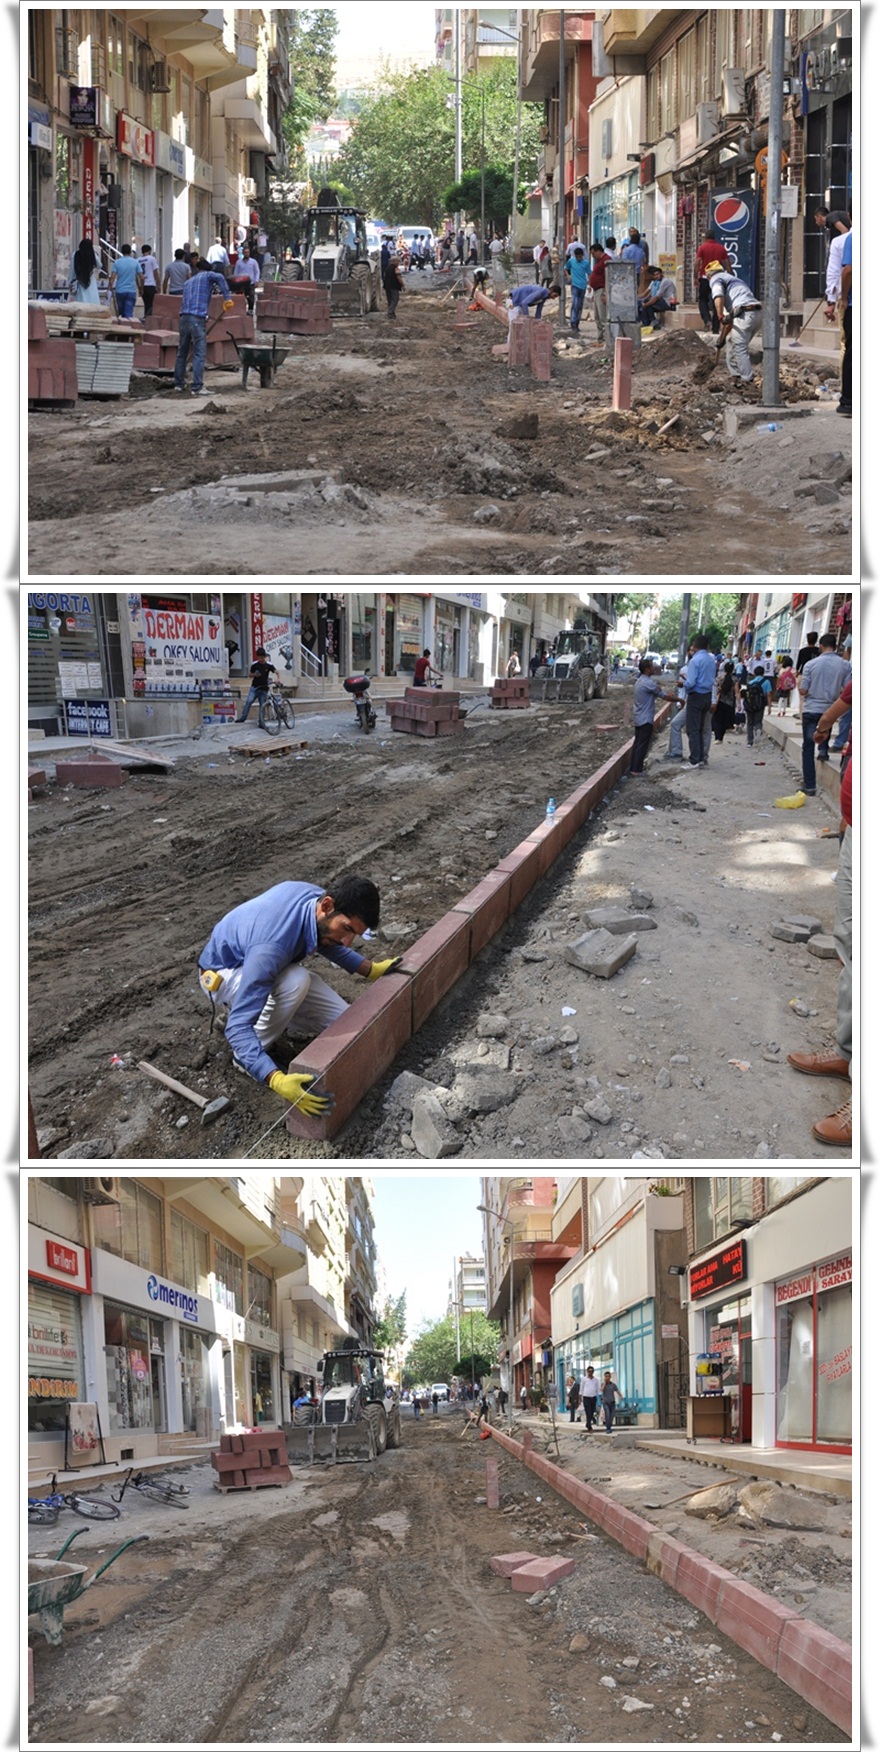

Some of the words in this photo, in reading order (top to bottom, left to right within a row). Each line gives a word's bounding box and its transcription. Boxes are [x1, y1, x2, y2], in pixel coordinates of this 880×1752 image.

[145, 611, 204, 640] DERMAN
[163, 645, 188, 659] OKEY
[189, 646, 220, 663] SALONU
[159, 1283, 198, 1313] merinos
